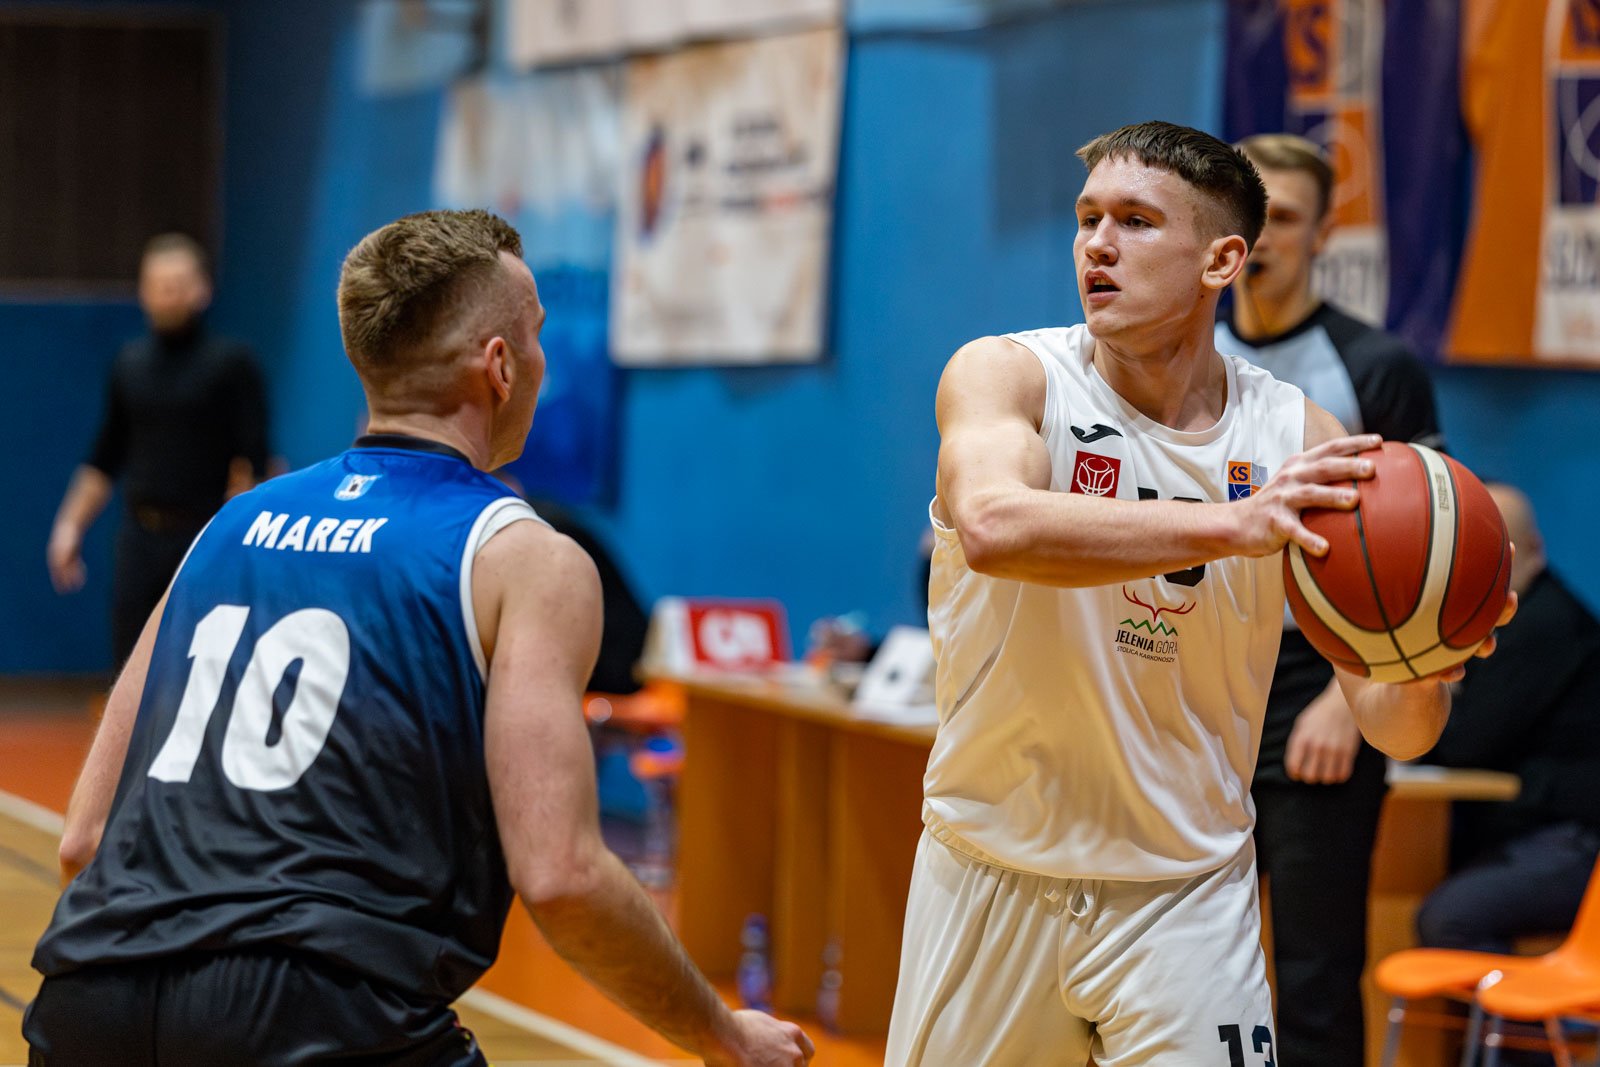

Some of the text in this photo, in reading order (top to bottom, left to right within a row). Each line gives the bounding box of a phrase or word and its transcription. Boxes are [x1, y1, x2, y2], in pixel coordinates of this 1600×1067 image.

[1230, 466, 1248, 481] KS
[243, 511, 388, 553] MAREK
[1115, 629, 1154, 652] JELENIA
[1116, 645, 1175, 663] STOLICA KARKONOSZY
[147, 605, 350, 791] 10
